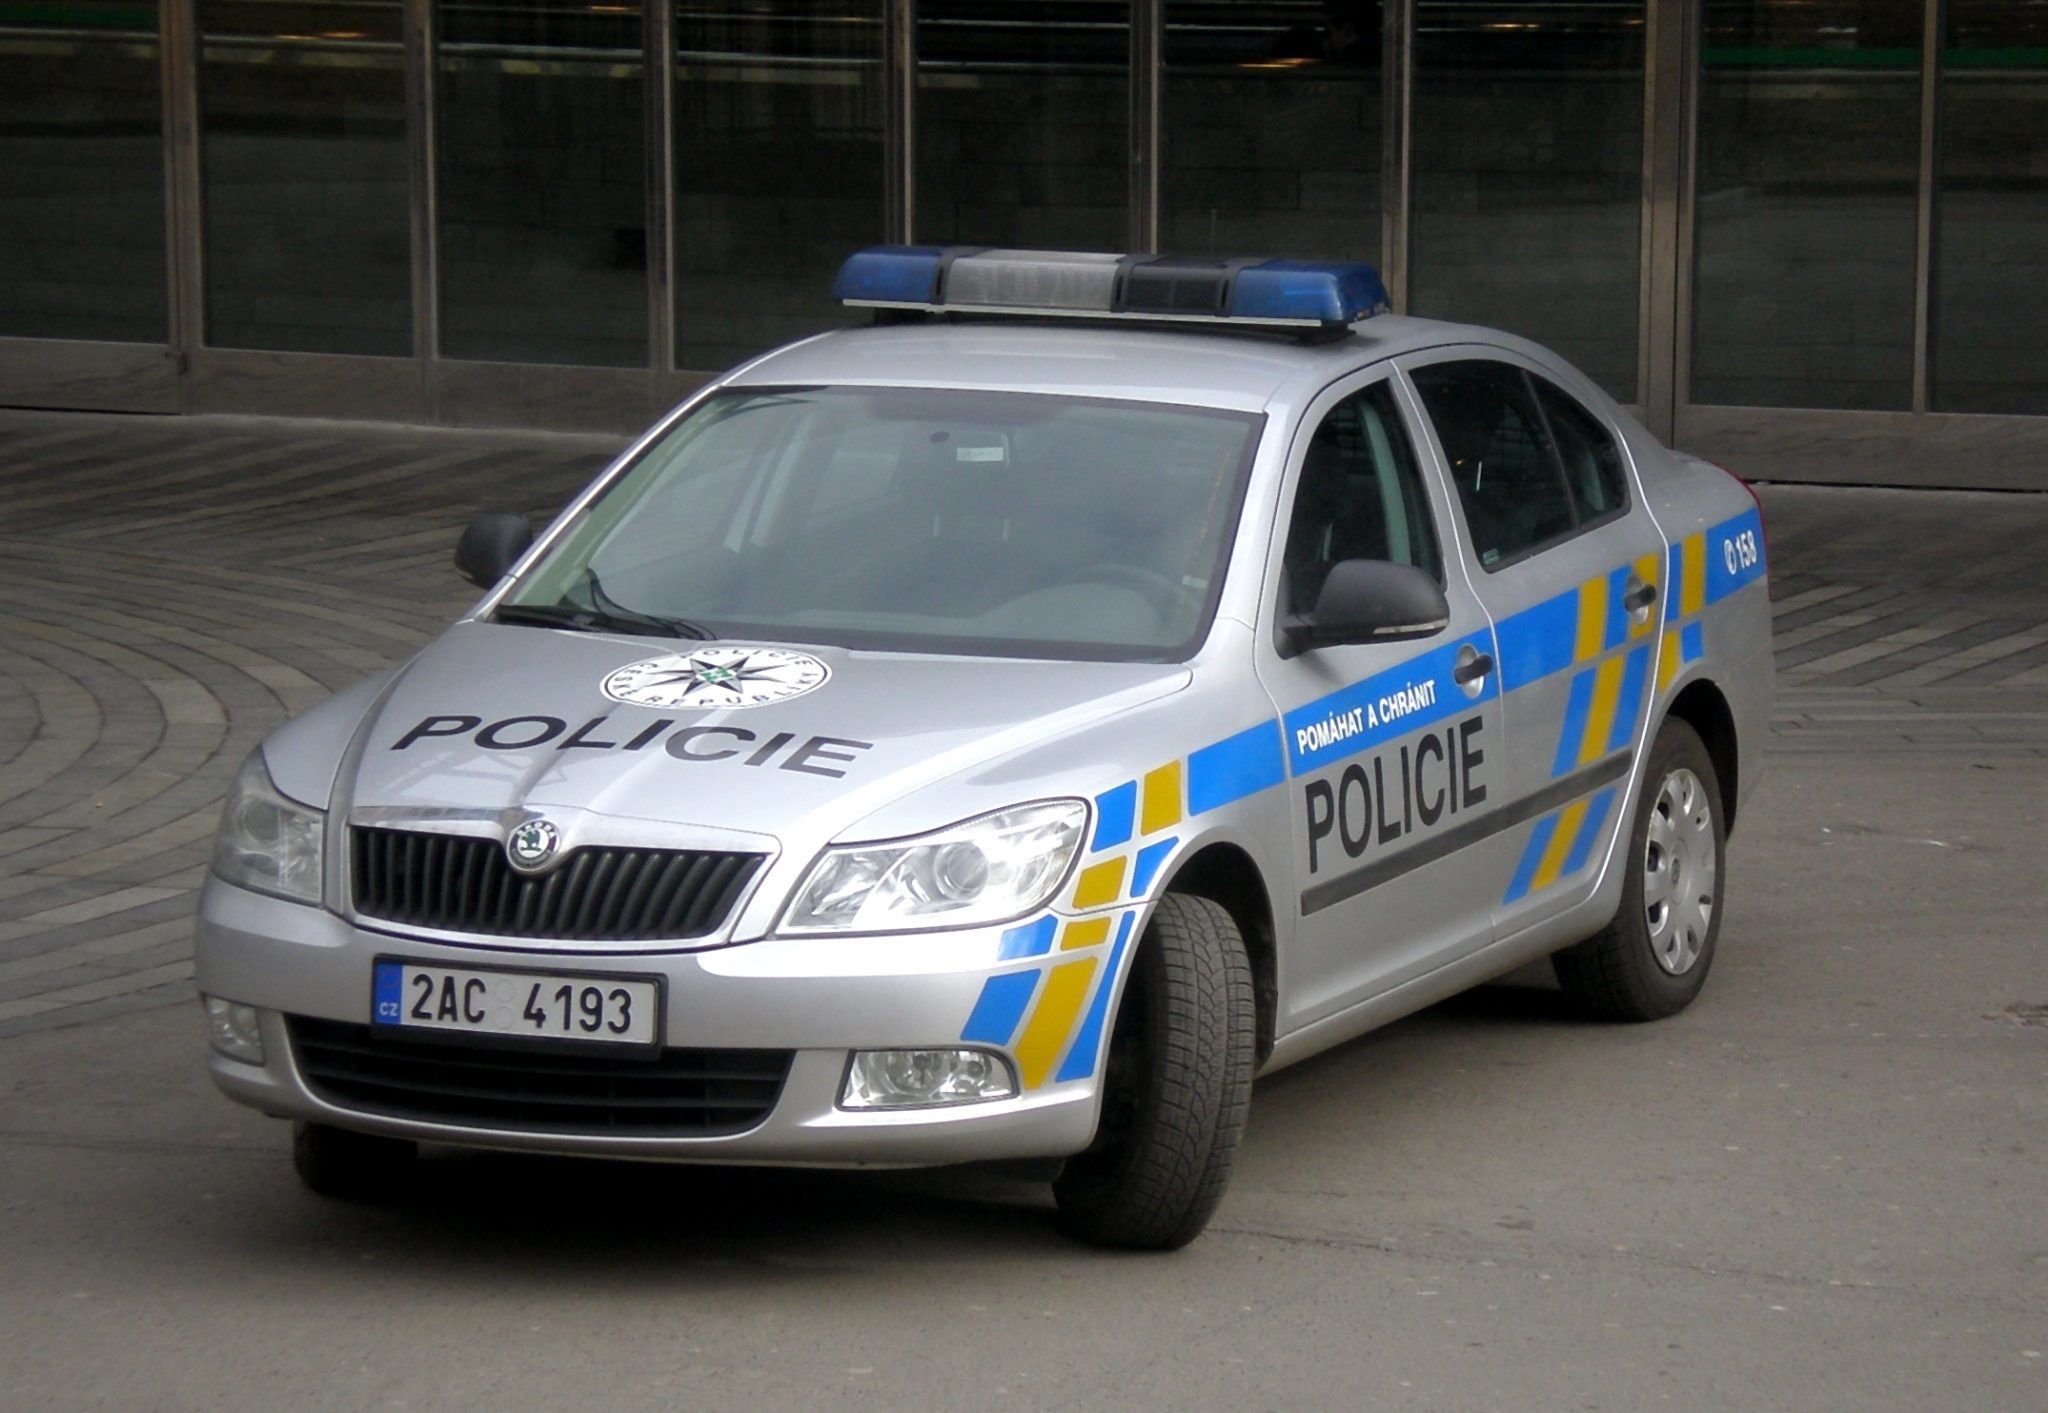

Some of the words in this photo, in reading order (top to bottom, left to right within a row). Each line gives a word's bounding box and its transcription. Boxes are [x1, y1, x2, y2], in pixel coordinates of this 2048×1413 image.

[1735, 530, 1757, 568] 158
[680, 648, 814, 667] POLICIE
[1296, 708, 1363, 755] POMÁHAT
[1368, 703, 1379, 730] A
[1379, 679, 1436, 724] CHRÁNIT
[391, 715, 873, 779] POLICIE
[1305, 716, 1487, 874] POLICIE
[379, 1002, 398, 1017] CZ
[411, 974, 486, 1023] 2AC
[523, 983, 632, 1033] 4193
